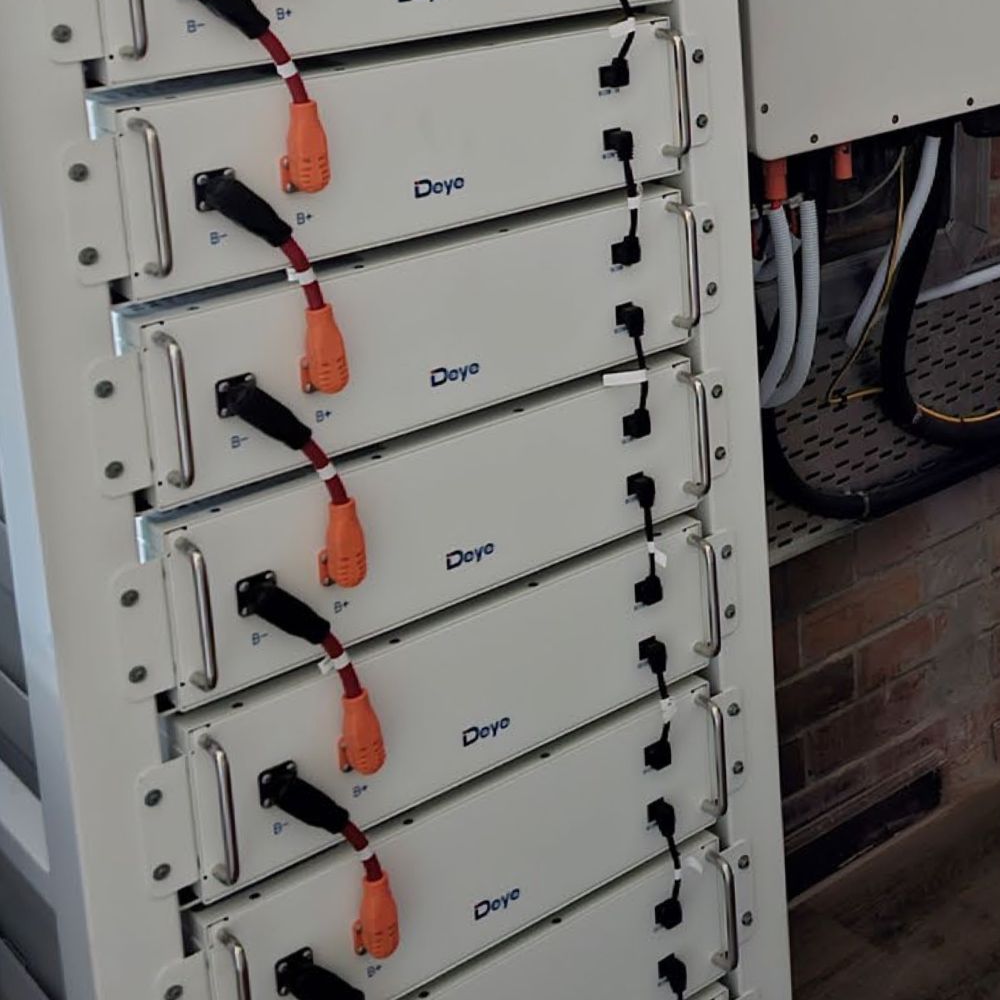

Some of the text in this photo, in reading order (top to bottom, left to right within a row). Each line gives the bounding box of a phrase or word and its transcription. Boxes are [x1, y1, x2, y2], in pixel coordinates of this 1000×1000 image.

[276, 8, 292, 20] B+
[187, 19, 205, 32] B-
[297, 212, 312, 225] B+
[210, 232, 228, 245] B-
[316, 410, 331, 422] B+
[231, 435, 249, 449] B-
[334, 601, 349, 613] B+
[252, 632, 268, 645] B-
